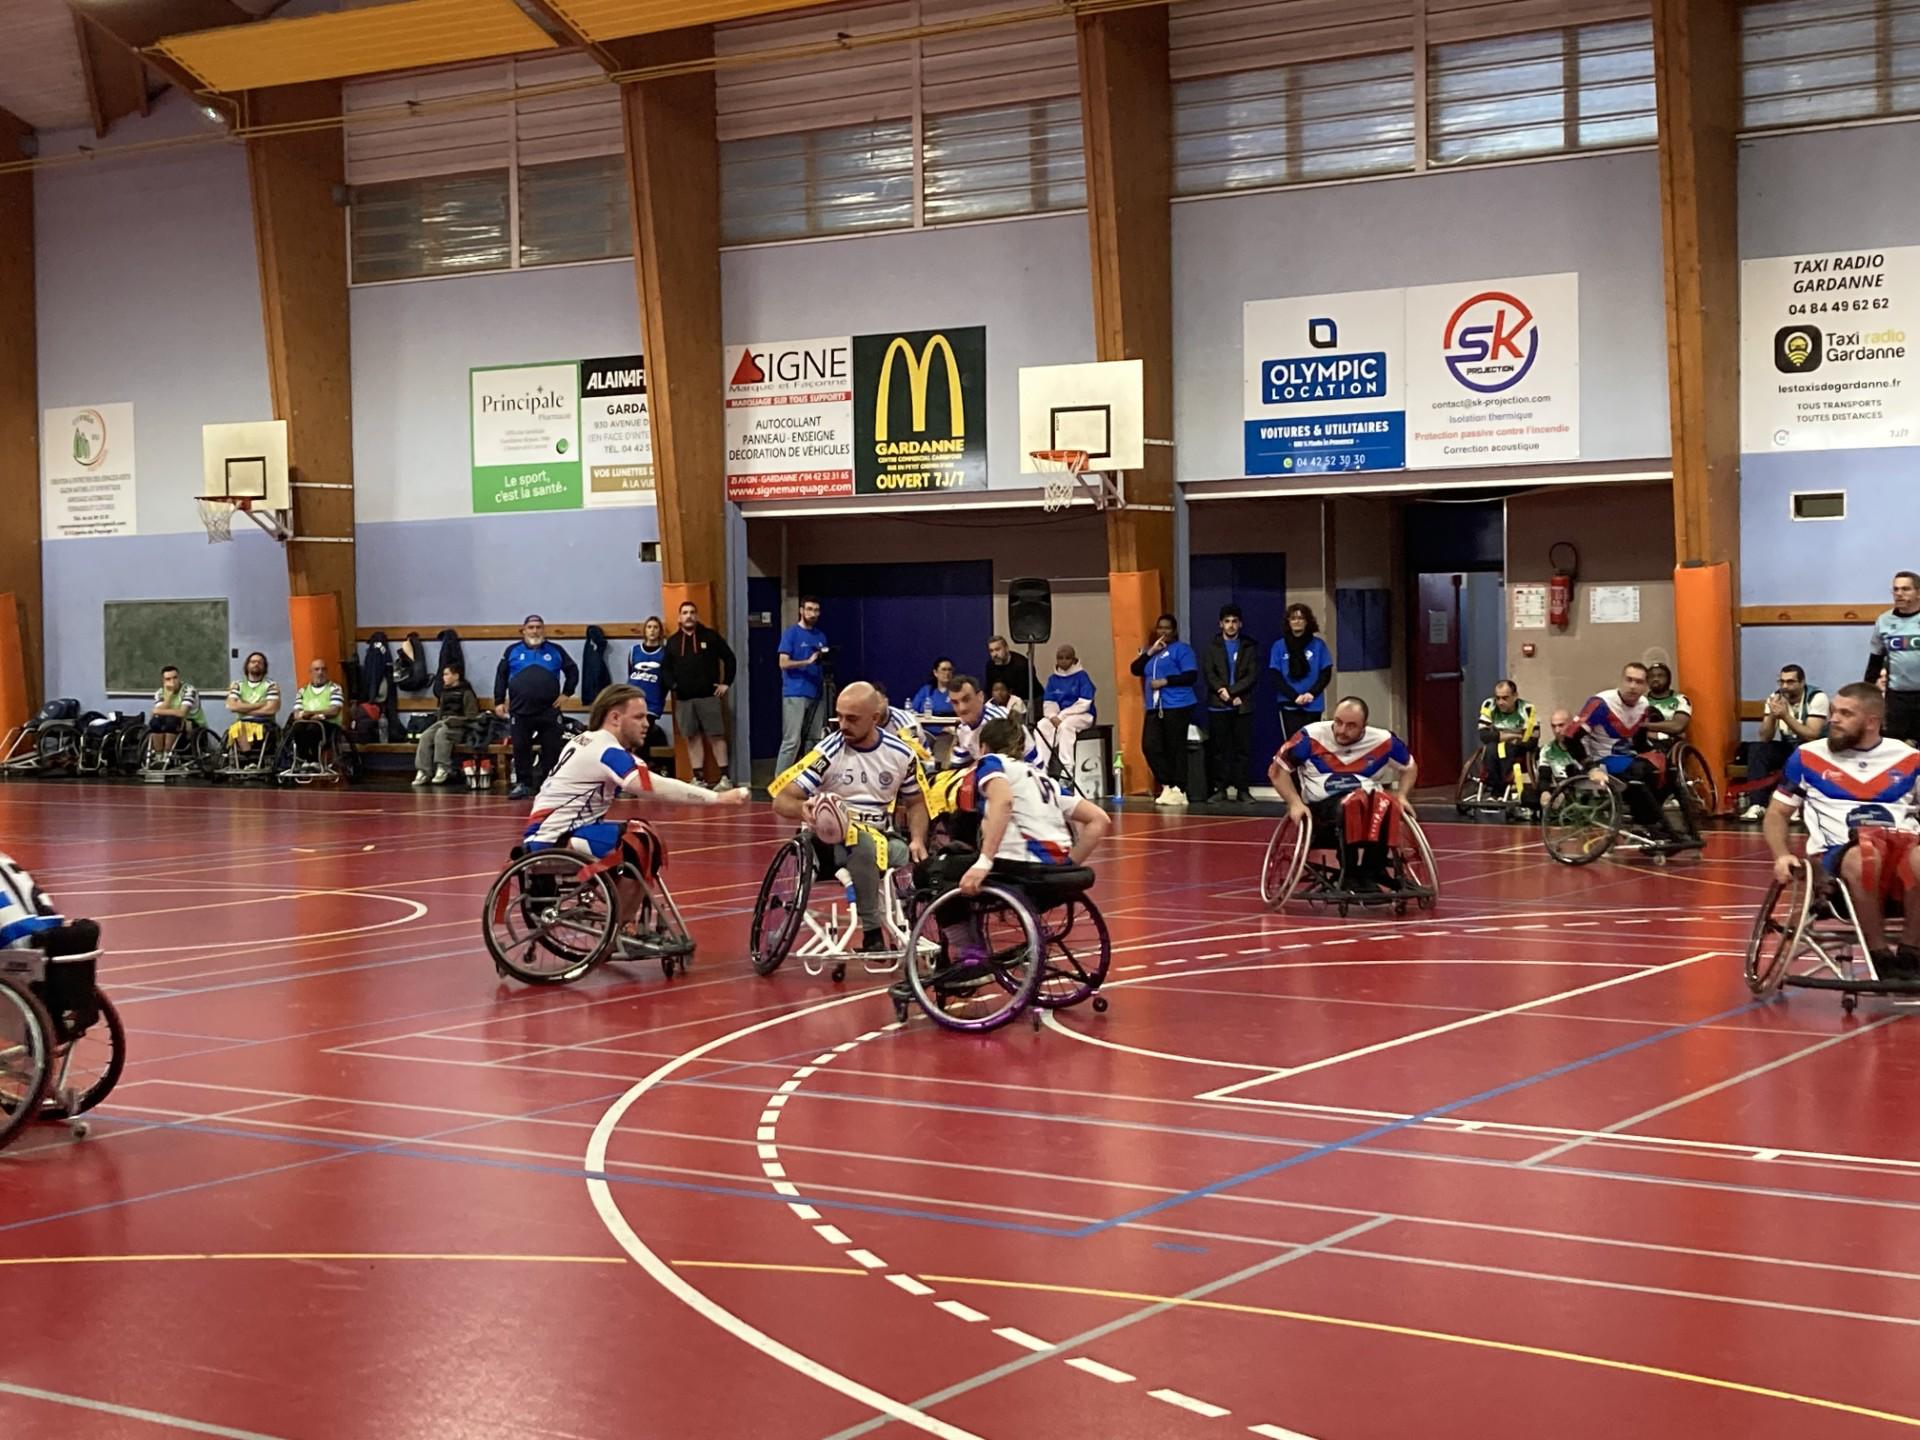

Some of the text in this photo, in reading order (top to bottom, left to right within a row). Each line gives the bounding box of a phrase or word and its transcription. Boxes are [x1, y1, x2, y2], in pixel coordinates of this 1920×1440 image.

[1793, 254, 1884, 274] TAXI RADIO
[1793, 273, 1885, 293] GARDANNE
[1788, 298, 1889, 315] 04 84 49 62 62
[1826, 329, 1906, 346] Taxi radio
[1826, 345, 1905, 362] Gardanne
[1270, 358, 1378, 386] OLYMPIC
[1466, 365, 1514, 375] PROJECTION
[729, 384, 775, 393] Marque
[1271, 382, 1377, 400] LOCATION
[1778, 379, 1902, 393] lestaxisdegardanne.fr
[482, 391, 564, 414] Principale
[731, 393, 846, 407] MARQUAGE SUR TOUS SUPPORTS
[1432, 395, 1551, 409] contact@sk-projection.com
[1797, 400, 1882, 410] TOUS TRANSPORTS
[607, 403, 647, 415] GARDA
[610, 419, 641, 427] AVENUE
[756, 416, 821, 430] AUTOCOLLANT
[1449, 412, 1533, 424] Isolation thermique
[1797, 411, 1882, 423] TOUTES DISTANCES
[603, 432, 623, 440] FACE
[742, 433, 786, 445] PANNEAU
[792, 430, 835, 442] ENSEIGNE
[1260, 421, 1389, 440] VOITURES & UTILITAIRES
[1415, 424, 1570, 441] Protection passive contre l'incendie
[729, 444, 850, 460] DÉCORATION DE VÉHICULES
[875, 439, 965, 455] GARDANNE
[1443, 442, 1540, 454] Correction acoustique
[1296, 454, 1365, 467] 04 42 52 30 30
[504, 470, 551, 487] Le sport,
[594, 468, 609, 478] VOS
[738, 476, 758, 484] AVON
[761, 474, 798, 483] GARDANNE
[822, 472, 830, 480] 52
[876, 471, 965, 489] OUVERT 7J/7
[629, 480, 639, 488] LA
[729, 483, 851, 496] www.signemarquage.com
[495, 481, 567, 503] c'est la santé.
